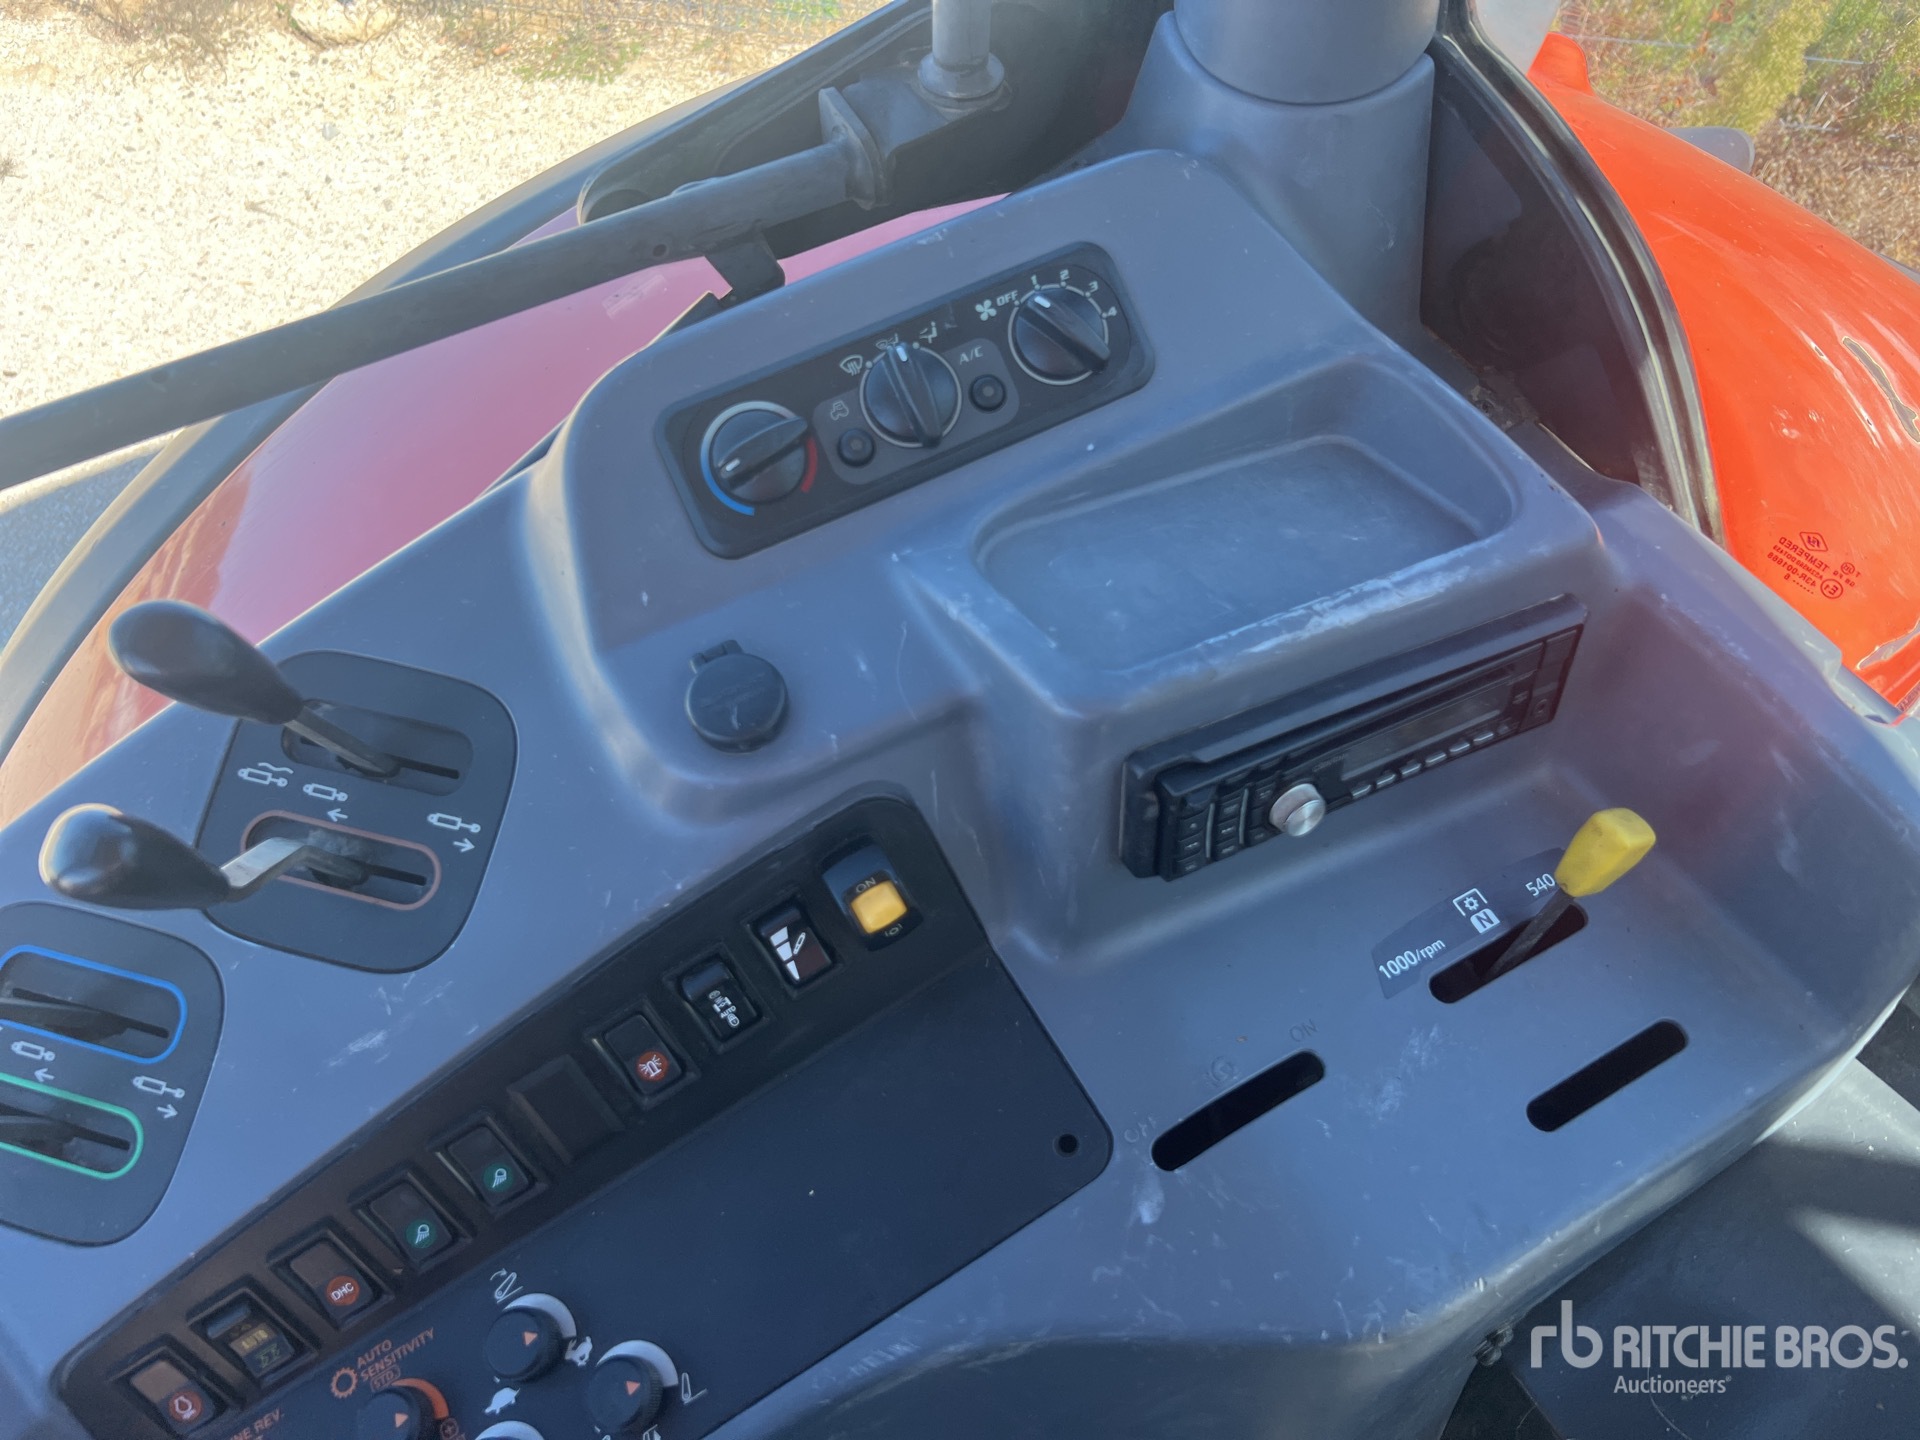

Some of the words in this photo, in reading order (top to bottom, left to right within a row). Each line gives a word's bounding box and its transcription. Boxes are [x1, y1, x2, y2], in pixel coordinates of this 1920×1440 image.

[1060, 269, 1070, 281] 2
[1089, 281, 1099, 292] 3
[996, 290, 1018, 307] OFF
[1107, 306, 1117, 317] 4
[959, 346, 983, 365] A/C
[855, 877, 876, 893] ON
[1525, 873, 1556, 897] 540
[1476, 912, 1495, 929] N
[1378, 938, 1446, 979] 1000/rpm
[1289, 1018, 1318, 1042] ON
[330, 1282, 354, 1302] DHC
[357, 1339, 393, 1369] AUTO
[360, 1327, 434, 1383] SENSITIVITY
